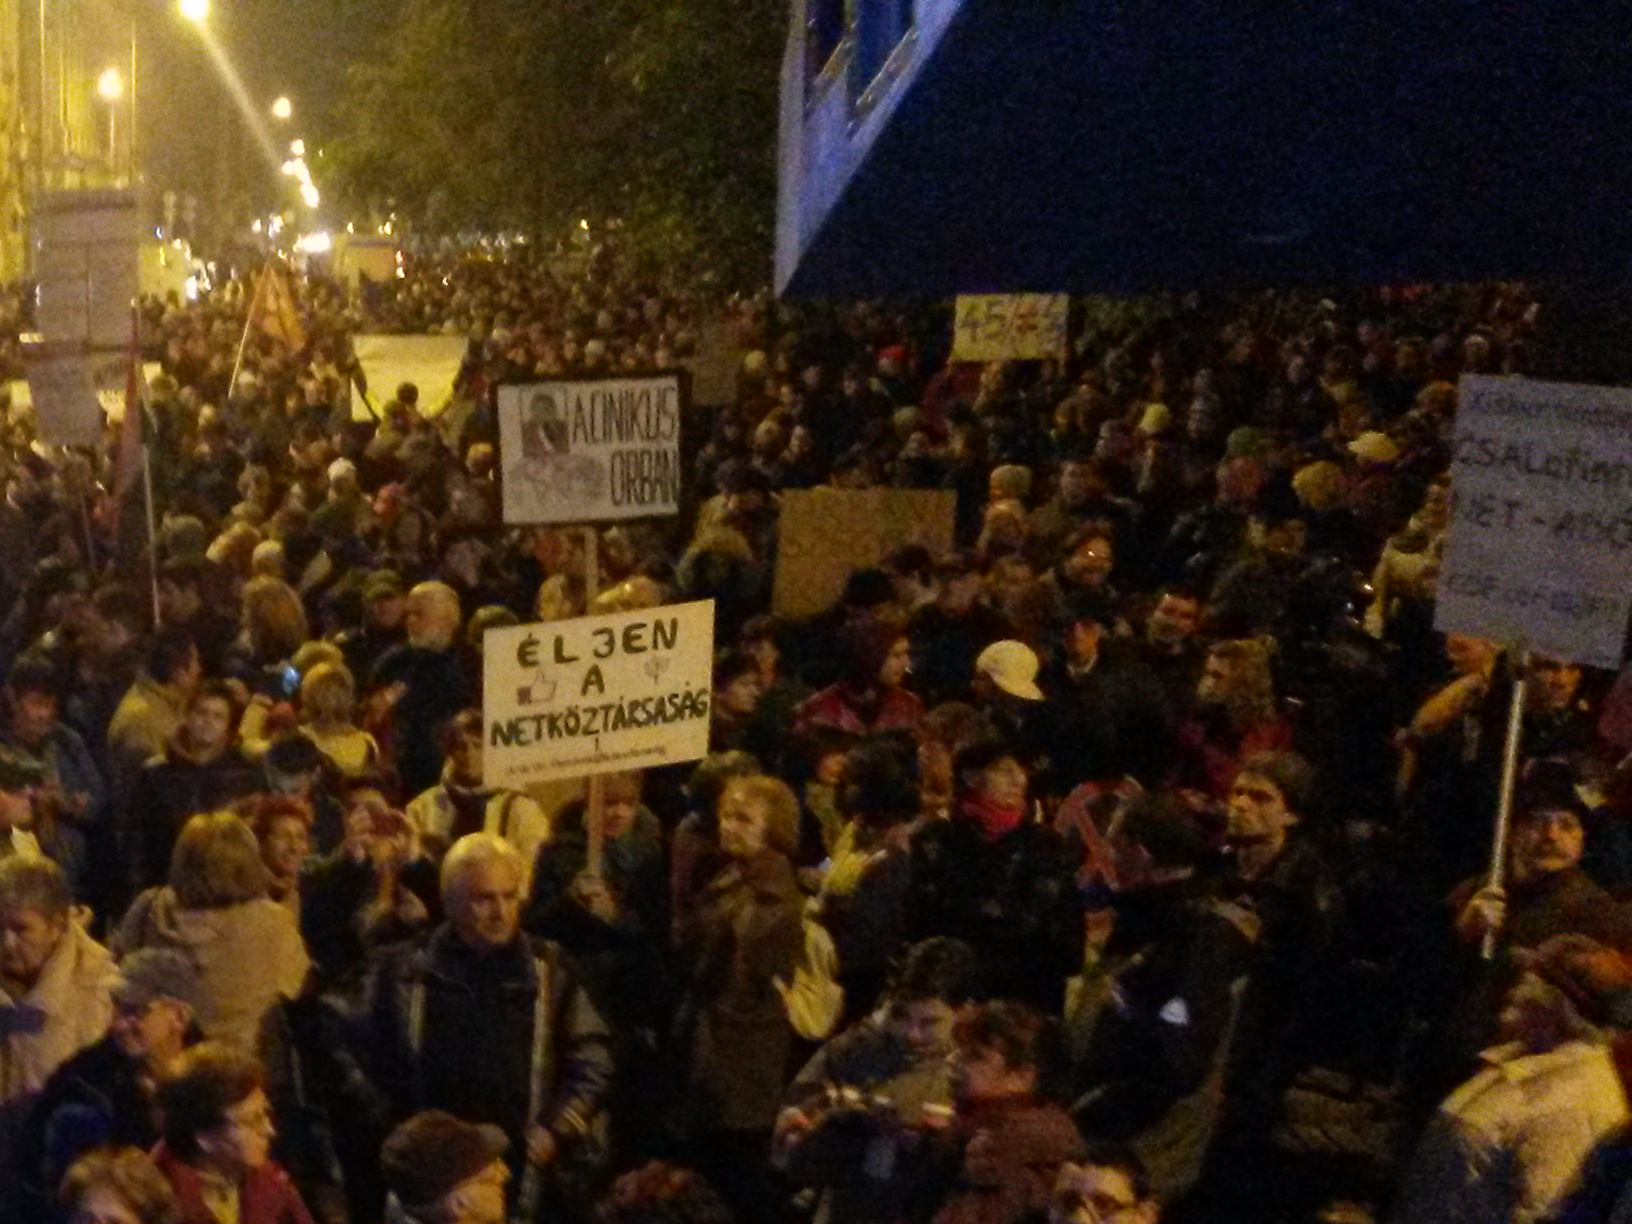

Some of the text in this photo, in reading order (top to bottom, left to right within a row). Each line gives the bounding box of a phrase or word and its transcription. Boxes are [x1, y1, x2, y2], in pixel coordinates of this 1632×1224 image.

[517, 617, 678, 668] ÉLJEN
[580, 664, 605, 696] A
[490, 681, 709, 747] NETKÖZTÁRSASÁG
